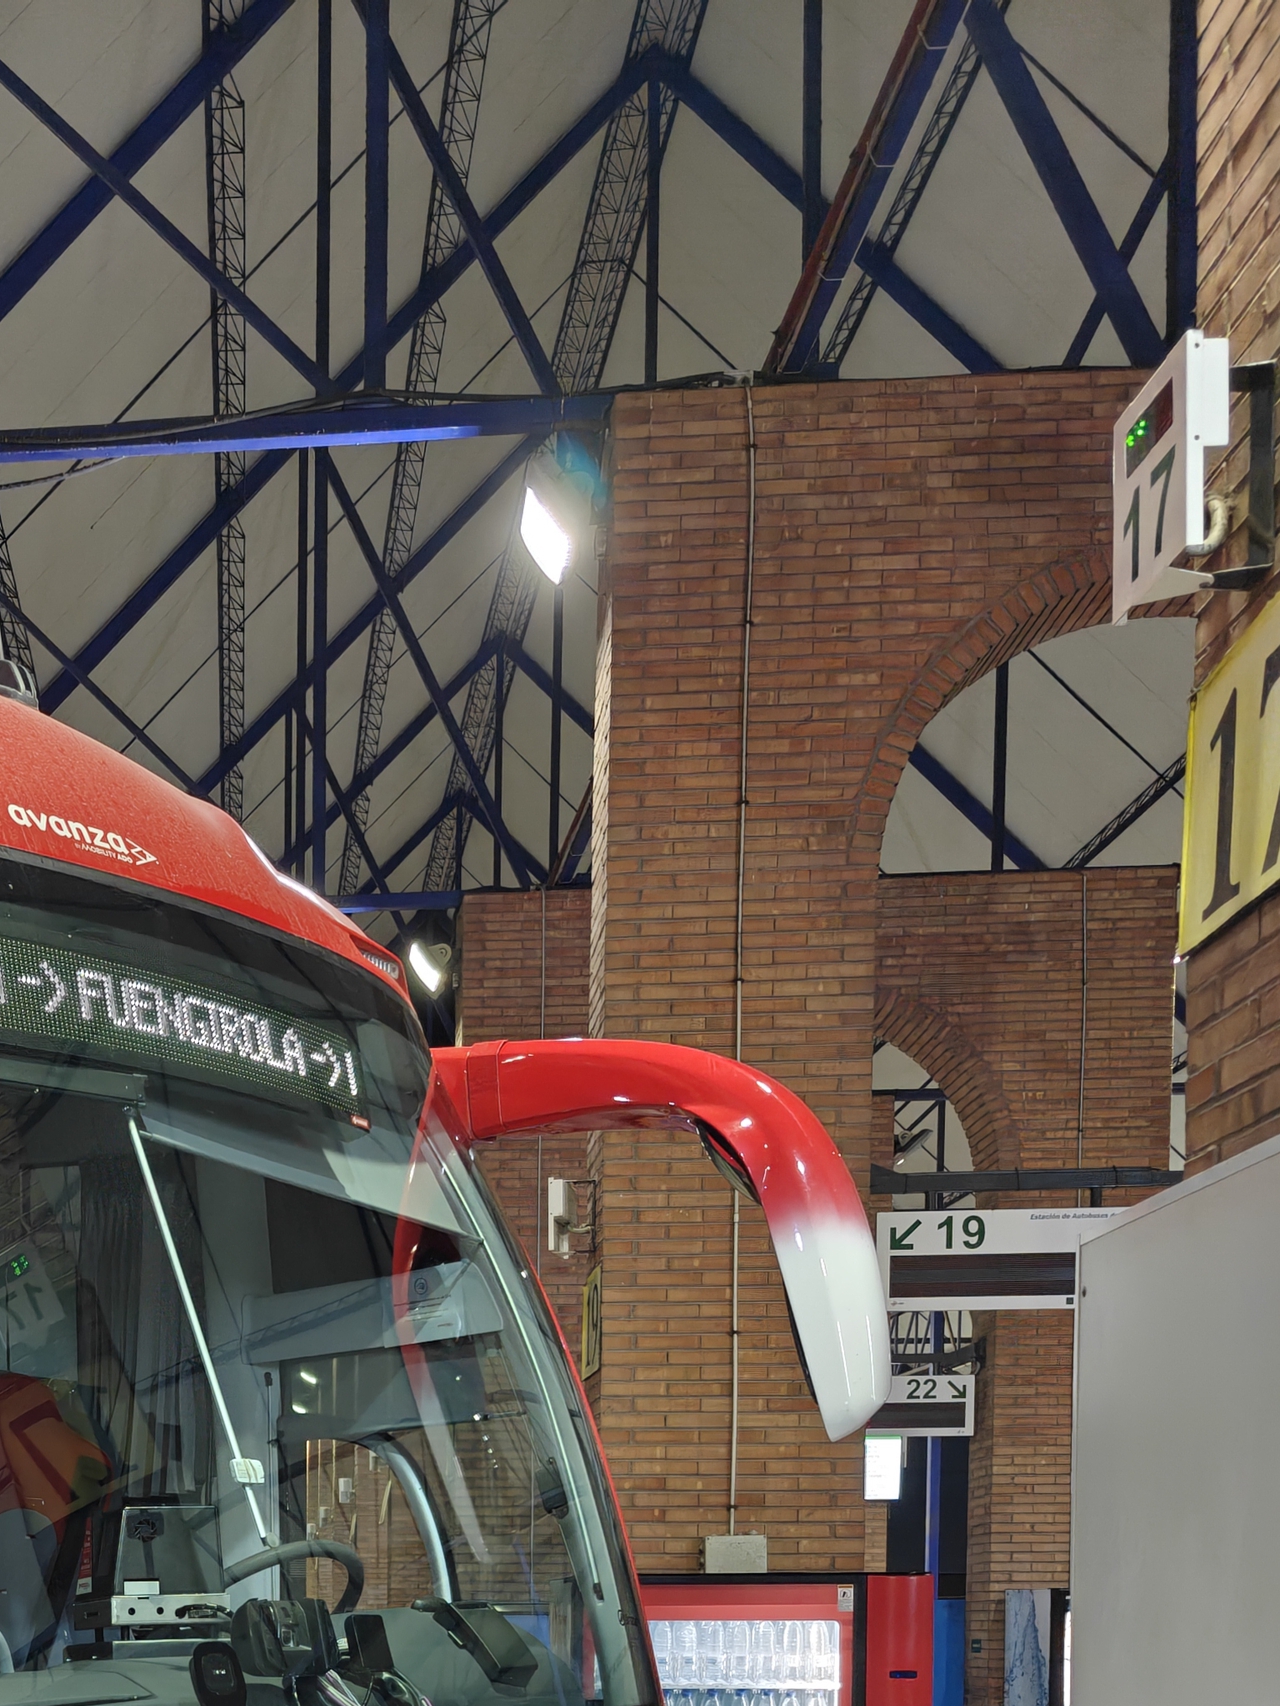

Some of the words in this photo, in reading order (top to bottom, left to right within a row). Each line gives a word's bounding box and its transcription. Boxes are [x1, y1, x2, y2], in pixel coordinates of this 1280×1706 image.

[1123, 444, 1176, 583] 17
[7, 803, 129, 855] avanza
[937, 1214, 986, 1250] 19
[1029, 1212, 1061, 1220] Estación
[1061, 1212, 1071, 1220] de
[906, 1378, 937, 1400] 22
